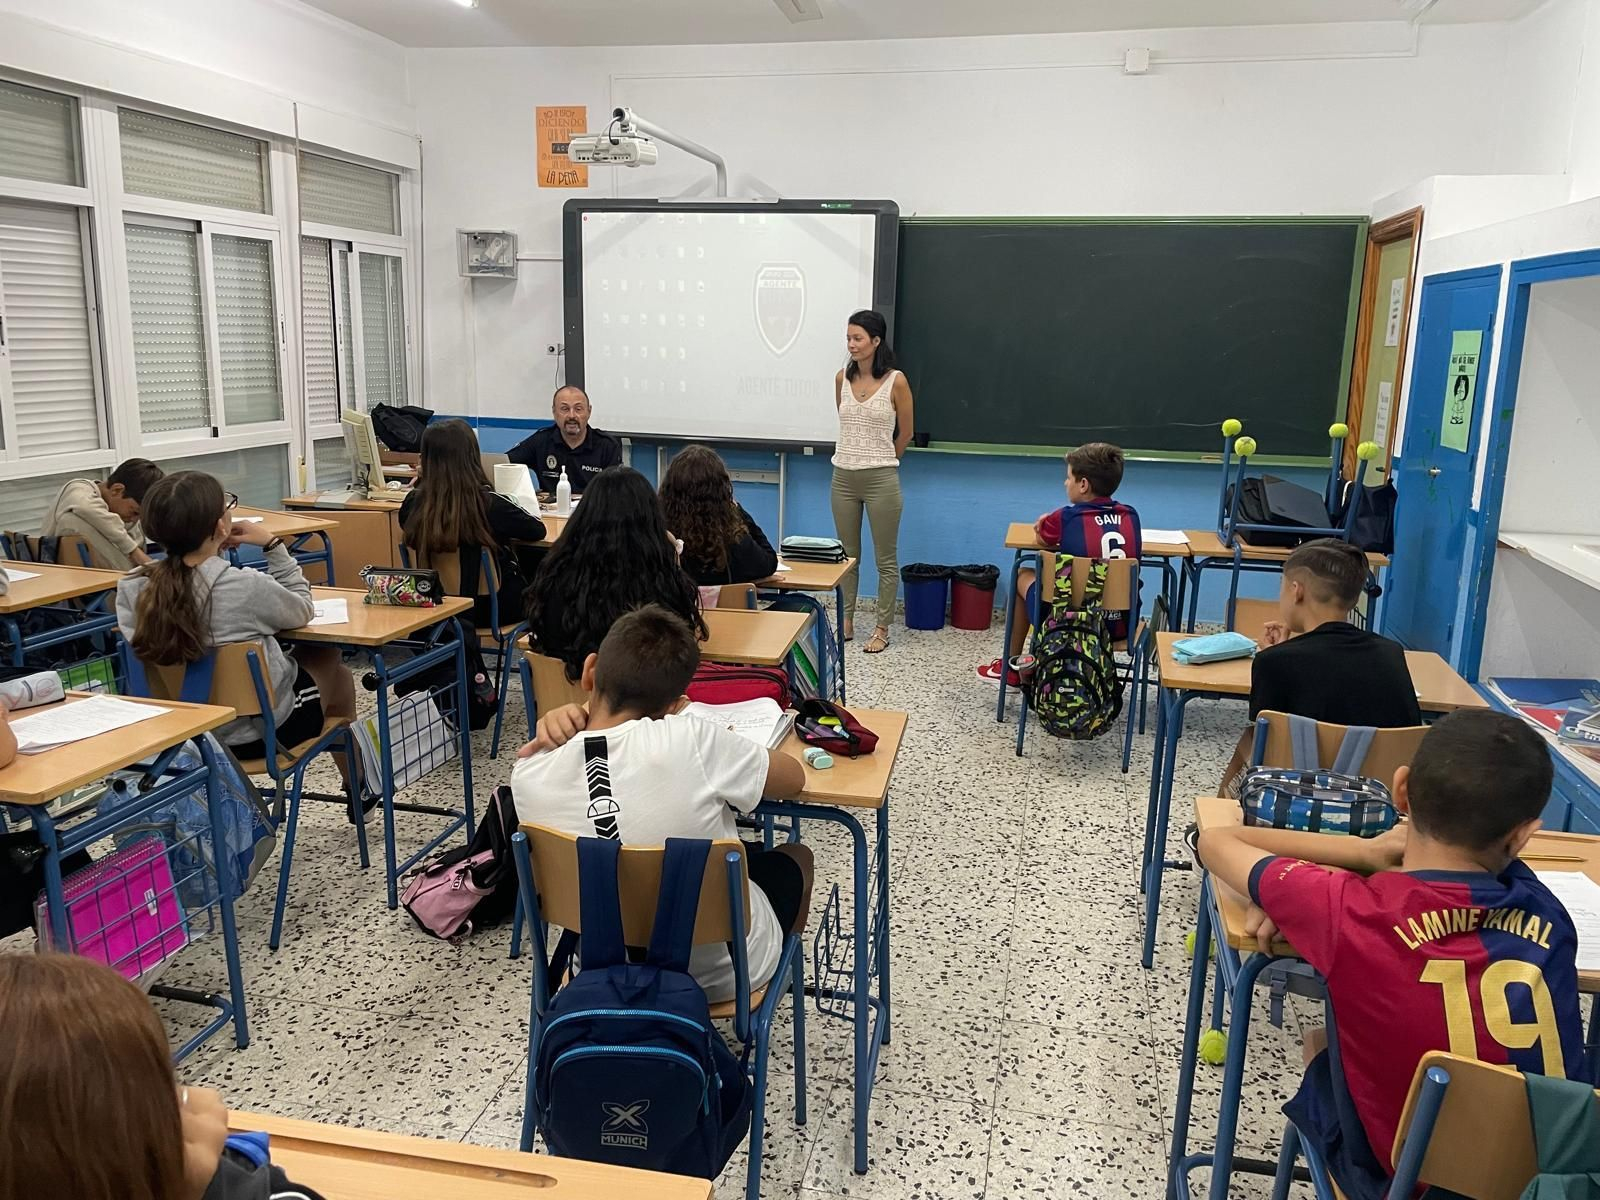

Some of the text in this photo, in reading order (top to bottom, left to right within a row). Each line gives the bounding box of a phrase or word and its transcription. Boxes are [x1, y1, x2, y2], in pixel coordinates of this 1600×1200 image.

[538, 119, 585, 127] DICIENDO
[546, 169, 556, 185] LA
[1094, 514, 1122, 526] GAVI
[1101, 531, 1126, 560] 6
[1393, 908, 1481, 950] LAMINE
[1482, 908, 1553, 950] YAMAL
[1419, 959, 1567, 1080] 19
[602, 1135, 647, 1147] MUNICH
